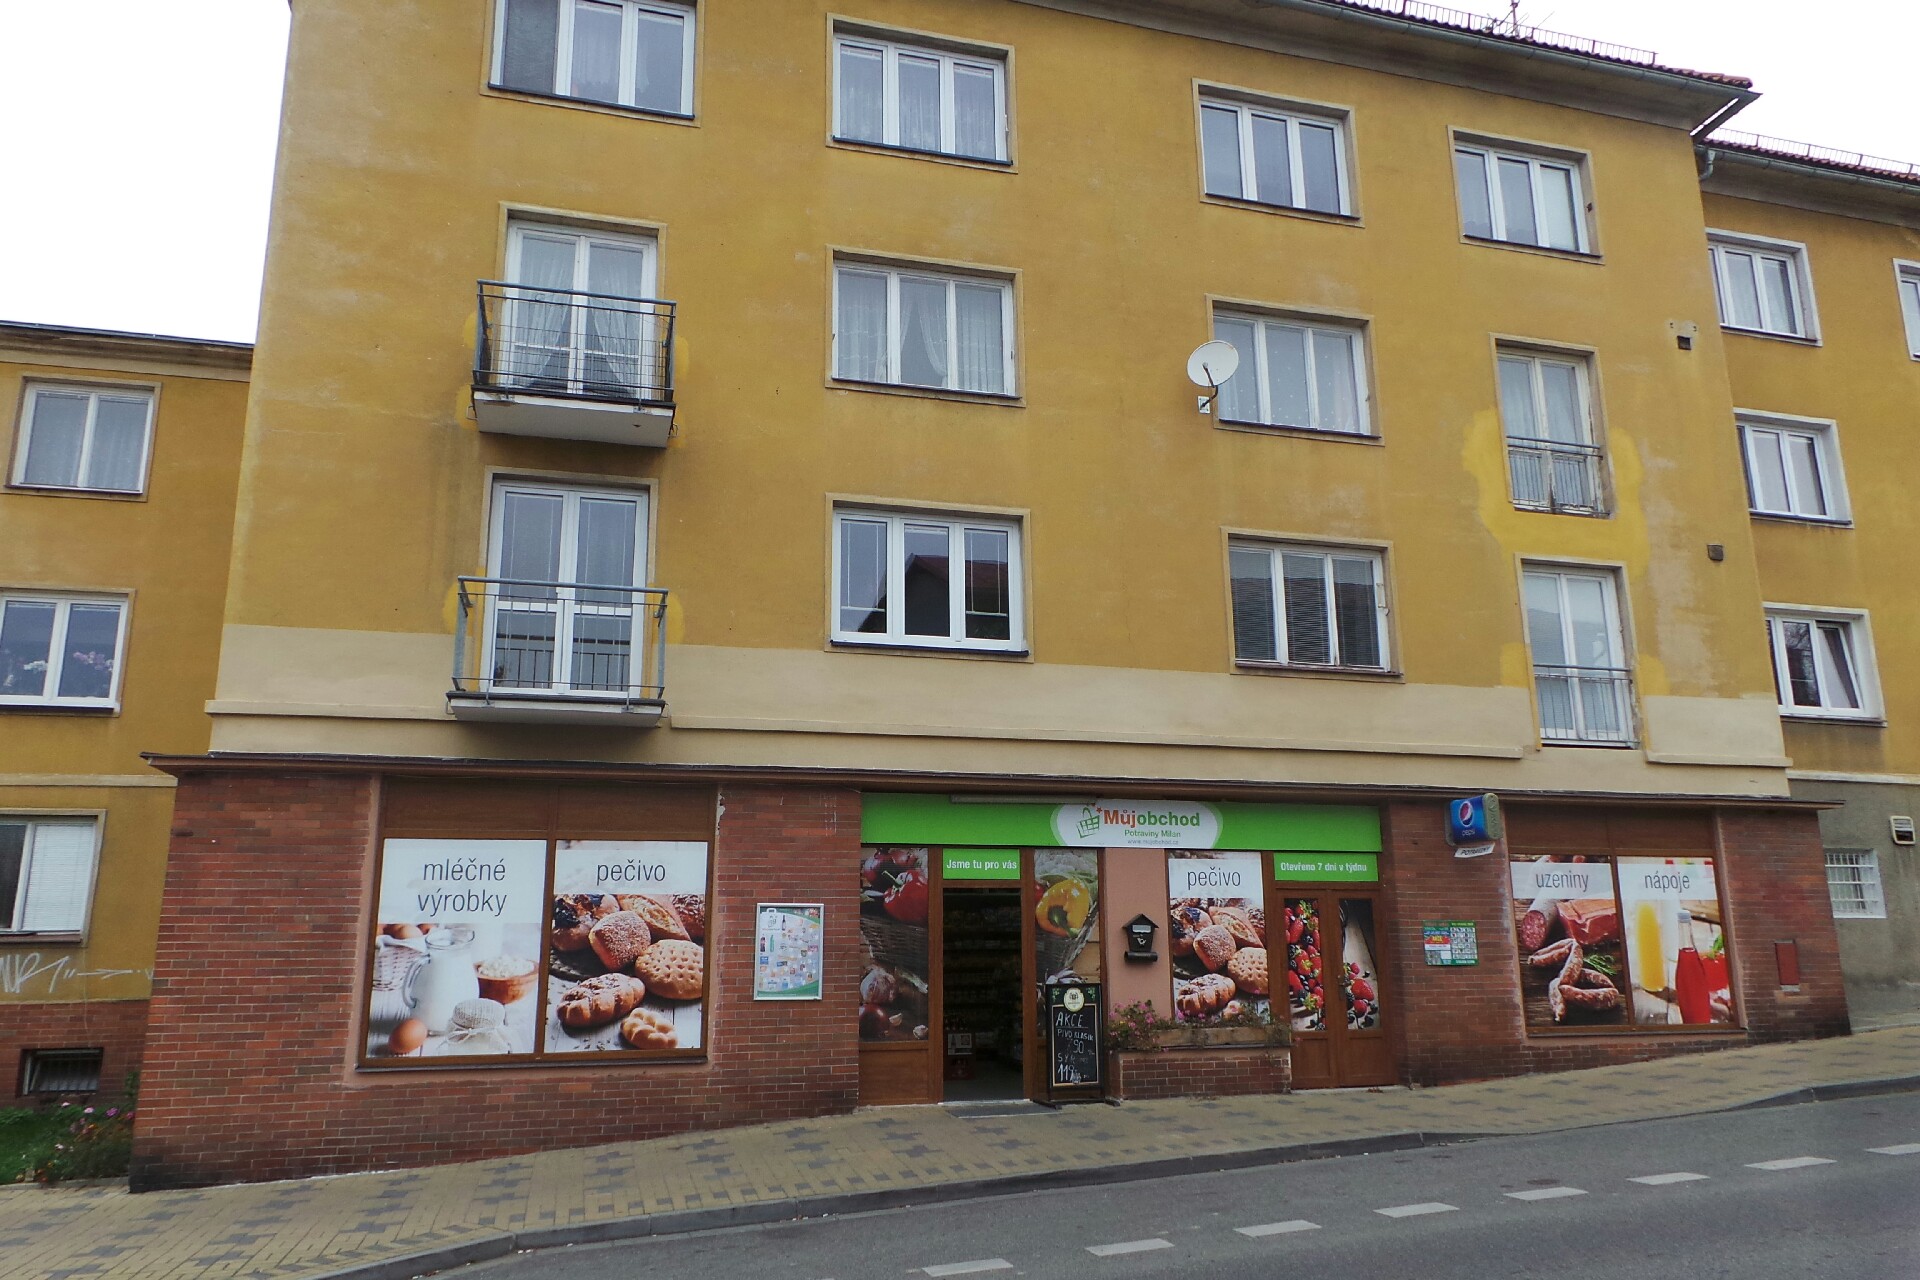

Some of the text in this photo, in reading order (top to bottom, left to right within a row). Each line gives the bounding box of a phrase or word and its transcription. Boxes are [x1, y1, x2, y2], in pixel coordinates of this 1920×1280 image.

[1103, 809, 1200, 828] Můjobchod
[1124, 829, 1181, 838] Potraviny Milan
[423, 858, 506, 881] mléčné
[596, 859, 666, 886] pečivo
[946, 860, 1017, 871] Jsme tu pro vás
[1317, 862, 1323, 871] 7
[1187, 866, 1241, 890] pečivo
[1536, 870, 1589, 892] uzeniny
[1644, 871, 1690, 893] nápoje
[417, 888, 507, 917] výrobky
[1055, 1011, 1084, 1028] AKCE
[1057, 1028, 1073, 1039] PIVO
